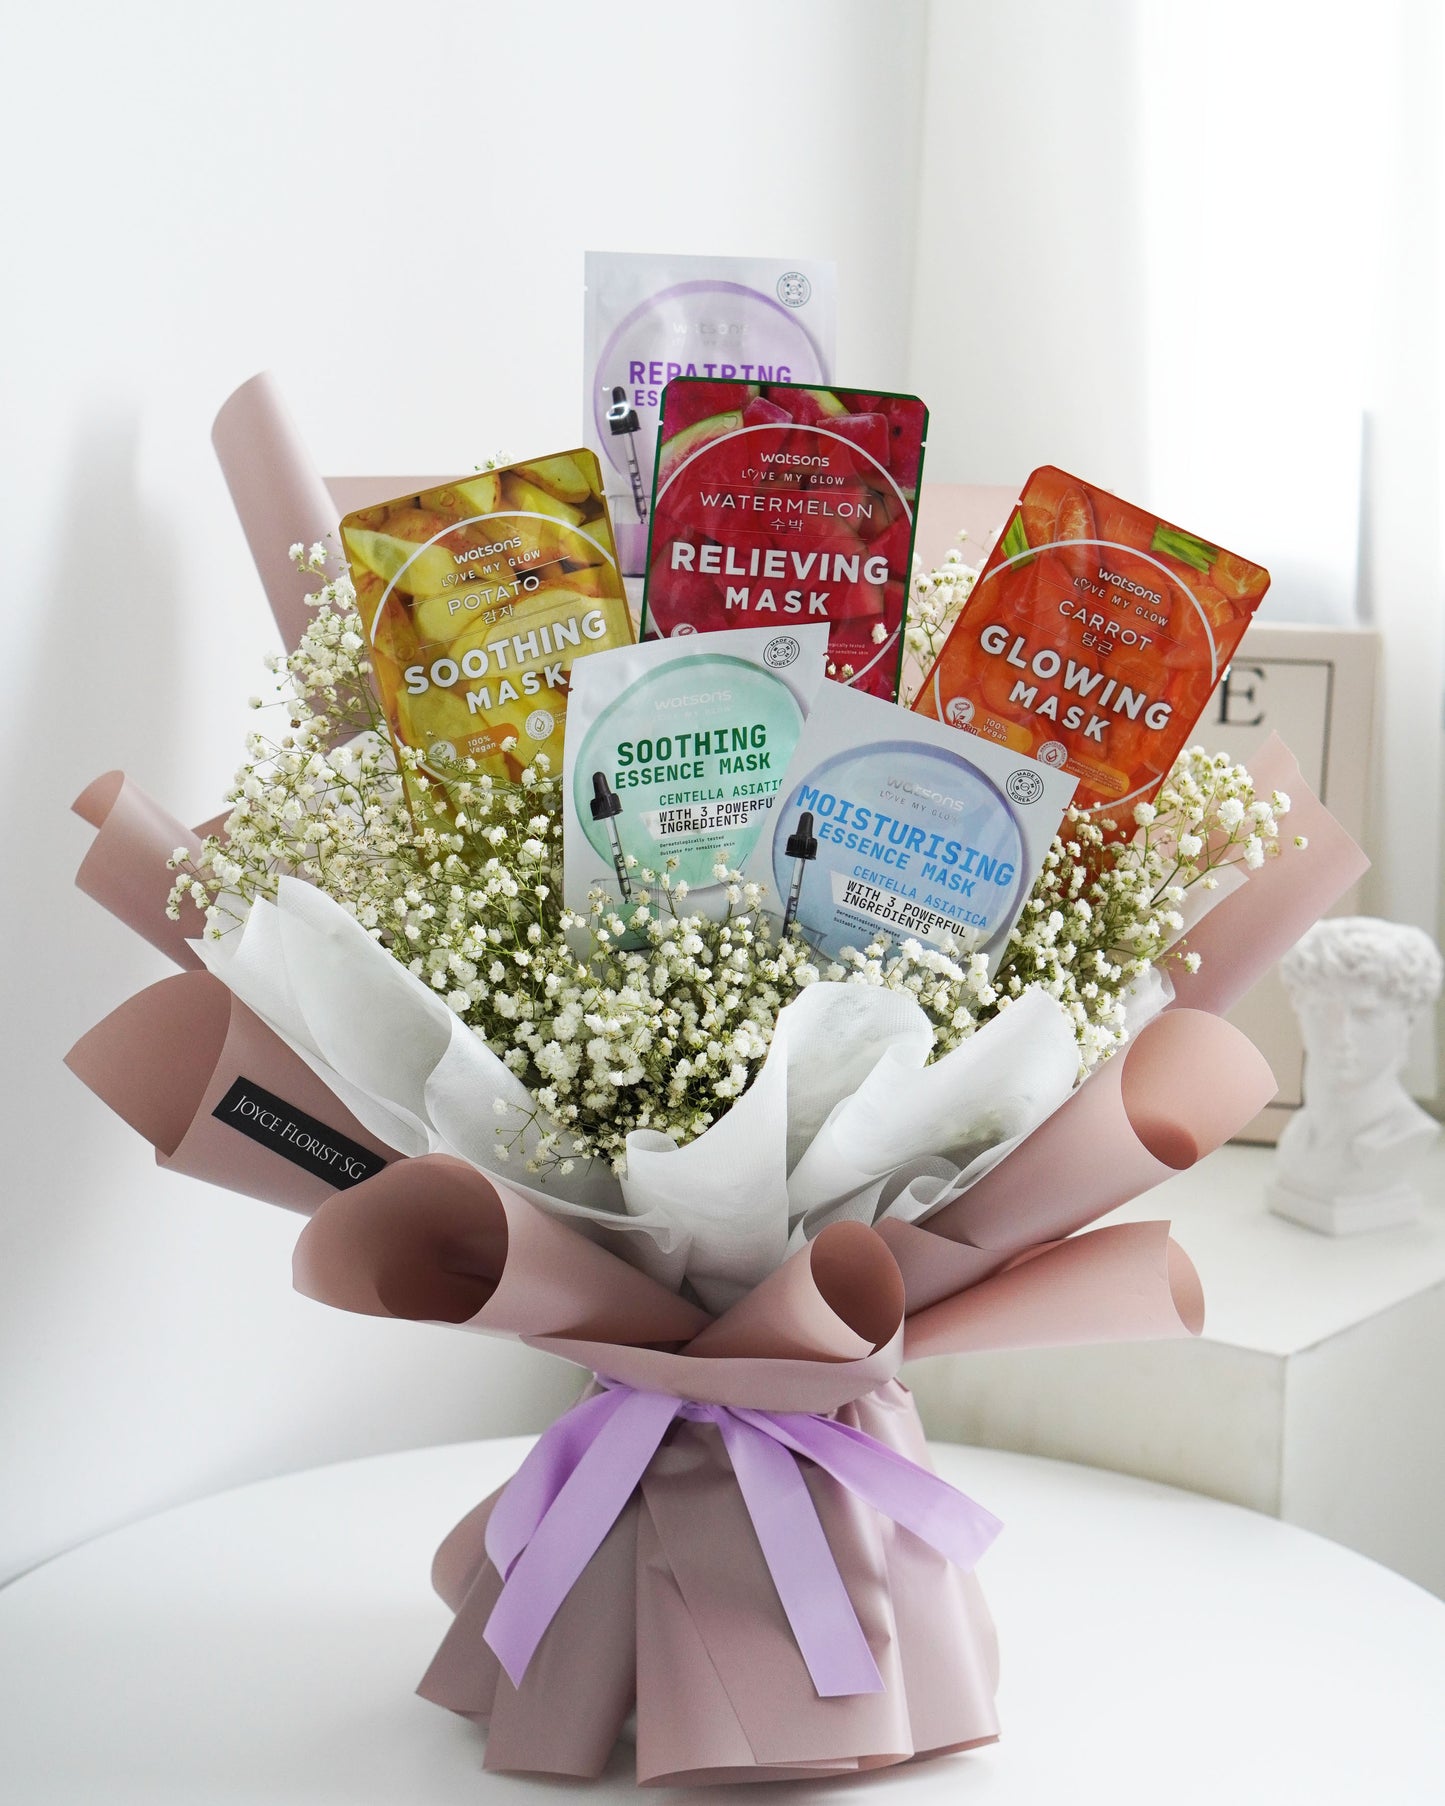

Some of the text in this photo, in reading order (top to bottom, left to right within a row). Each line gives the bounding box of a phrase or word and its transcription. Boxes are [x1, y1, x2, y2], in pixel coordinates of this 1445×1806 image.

[760, 452, 830, 467] watsons
[784, 473, 803, 482] MY
[810, 475, 845, 485] GLOW
[700, 491, 873, 519] WATERMELON
[770, 518, 804, 531] 수박
[453, 536, 522, 565] watsons
[483, 562, 501, 575] MY
[508, 548, 541, 567] GLOW
[671, 541, 889, 585] RELIEVING
[447, 575, 540, 616] POTATO
[725, 586, 830, 616] MASK
[1098, 568, 1162, 604] watsons
[481, 603, 514, 625] 감자
[1058, 600, 1152, 651] CARROT
[1112, 595, 1130, 609] MY
[1135, 605, 1169, 627] GLOW
[404, 609, 607, 695] SOOTHING
[1081, 631, 1114, 656] 당근
[466, 662, 568, 714] MASK
[980, 625, 1173, 730] GLOWING
[654, 690, 733, 710] watsons
[1009, 680, 1112, 743] MASK
[467, 735, 491, 747] 100%
[469, 742, 496, 754] Vegan
[617, 724, 767, 767] SOOTHING
[983, 724, 1008, 742] Vegan
[615, 752, 771, 790] ESSENCE MASK
[658, 796, 776, 823] WITH 3 POWERFU
[659, 787, 724, 806] CENTELLA
[911, 801, 927, 812] MY
[660, 813, 748, 835] INGREDIENTS
[796, 784, 1016, 888] MOISTURISING
[818, 822, 977, 898] ESSENCE MASK
[846, 880, 966, 938] WITH 3 POWERFUL
[853, 865, 988, 928] CENTELLA ASIATICA
[842, 891, 931, 935] INGREDIENTS
[230, 1095, 367, 1180] JOYCE FLORIST SG
